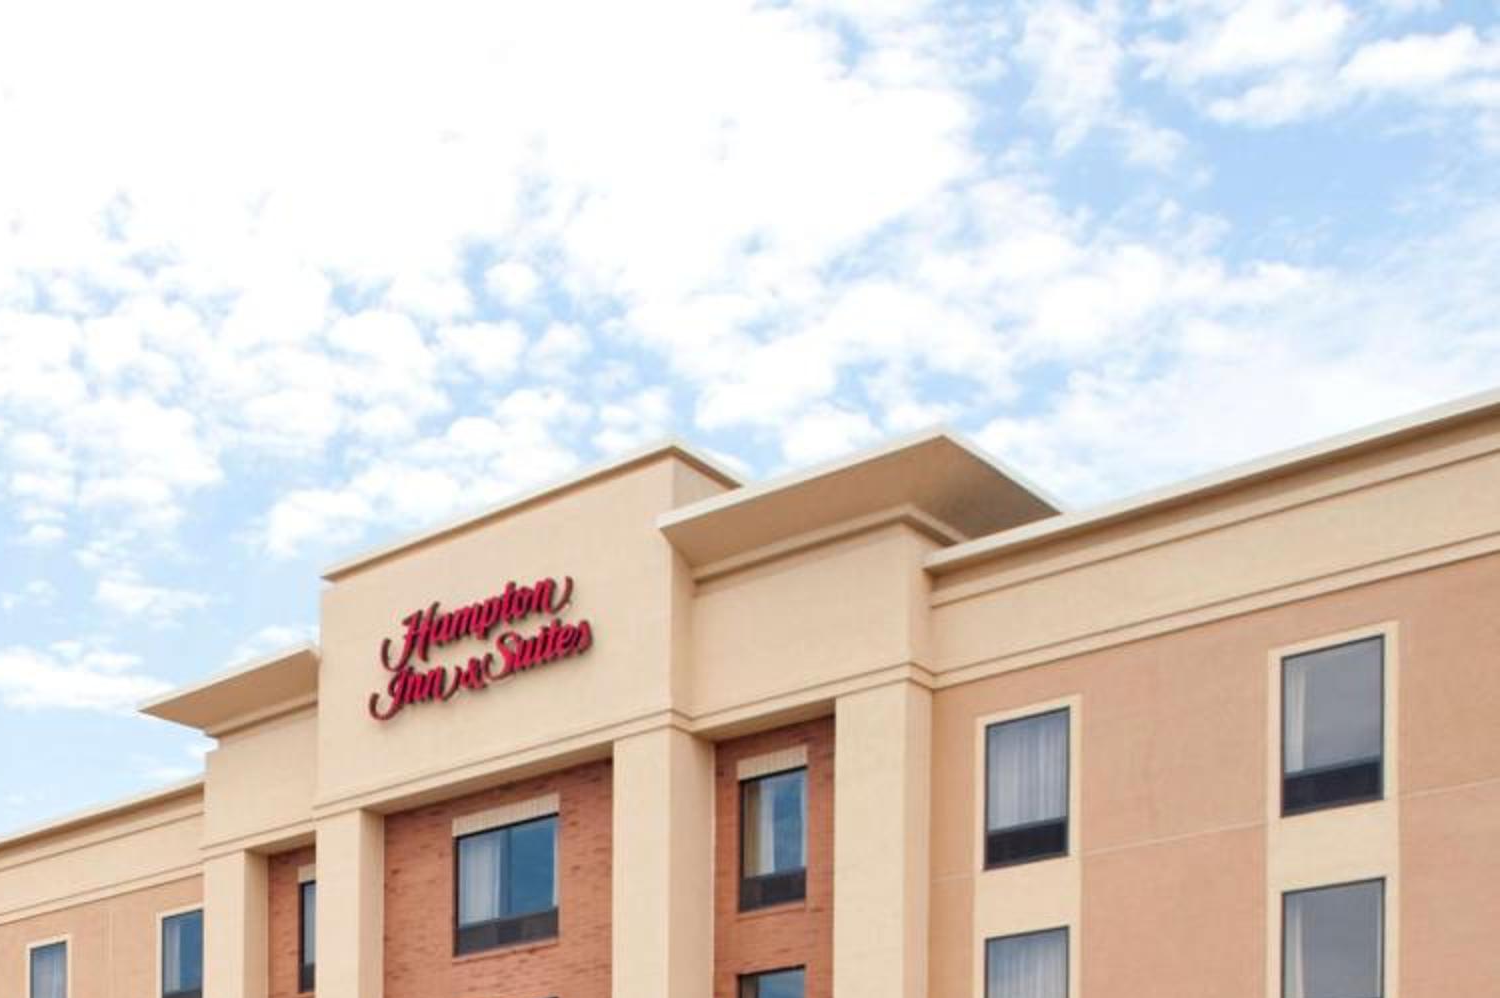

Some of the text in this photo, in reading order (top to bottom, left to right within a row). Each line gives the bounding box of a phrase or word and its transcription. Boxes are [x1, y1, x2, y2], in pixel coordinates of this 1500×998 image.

[369, 666, 462, 720] Inn
[486, 618, 593, 680] Suites
[381, 576, 574, 672] Hampton
